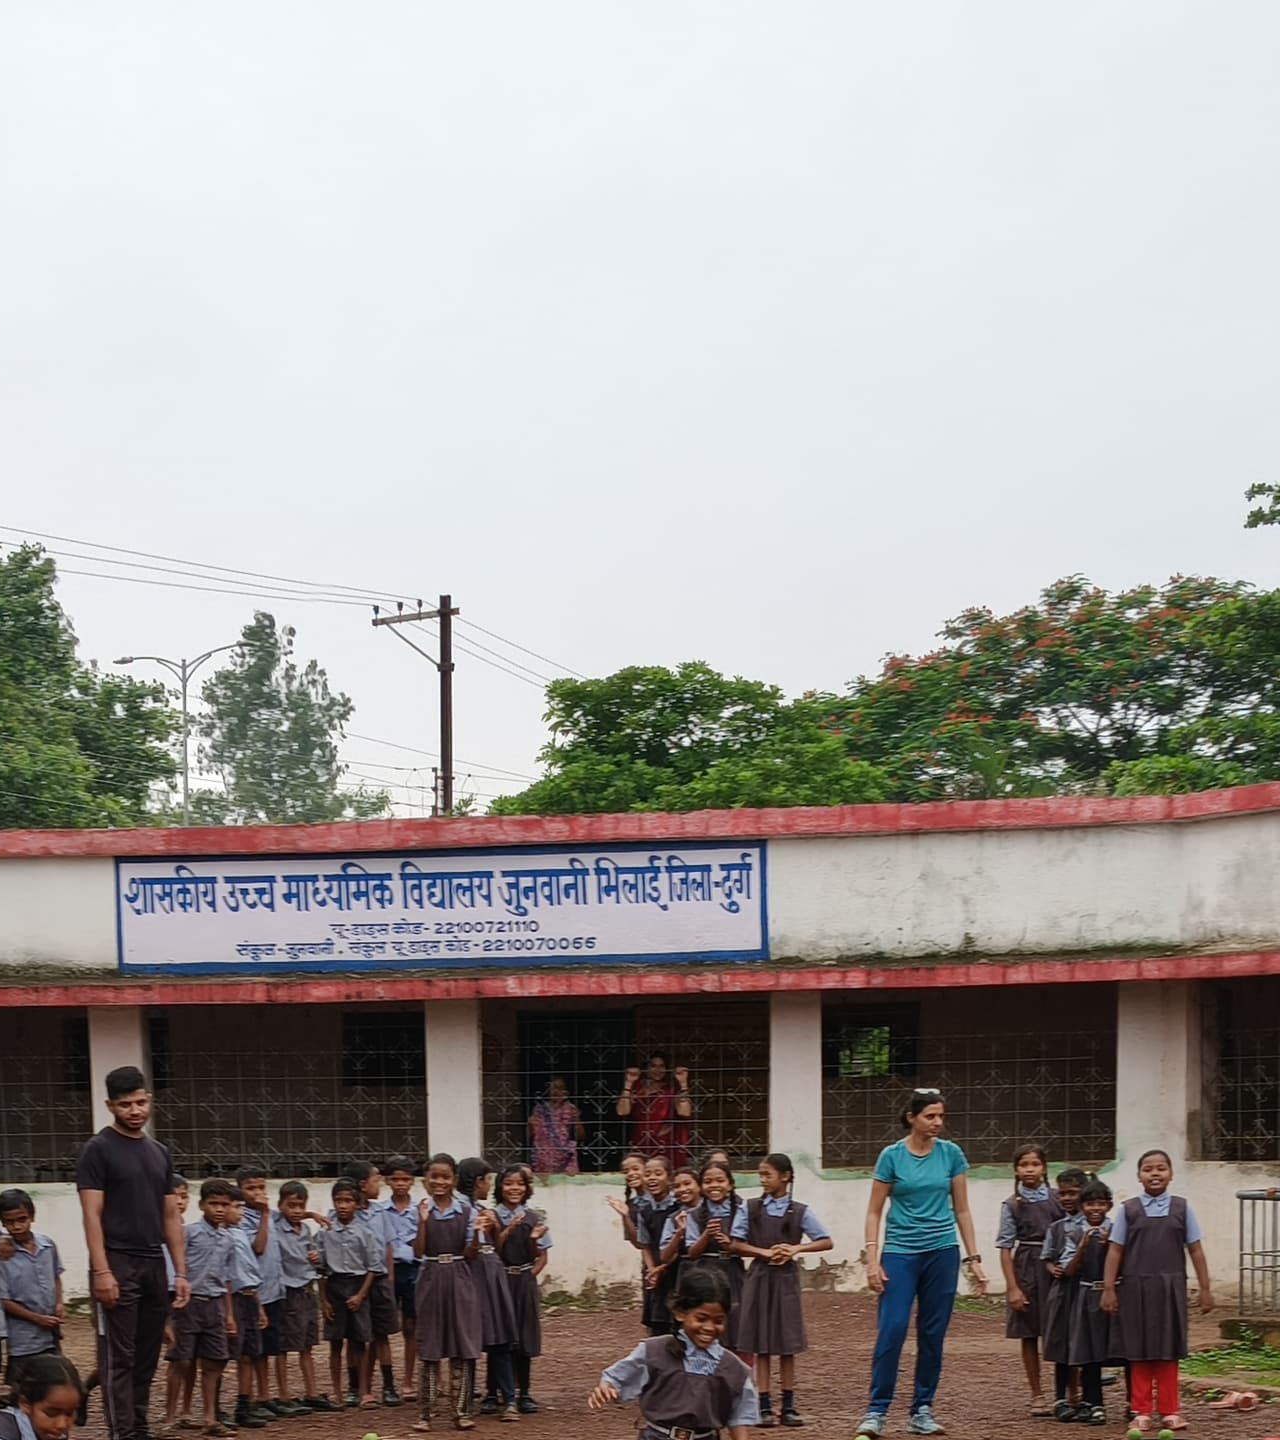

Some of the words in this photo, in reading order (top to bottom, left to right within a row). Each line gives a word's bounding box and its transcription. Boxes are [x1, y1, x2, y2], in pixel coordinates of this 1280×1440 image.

[124, 864, 217, 915] शासकीय
[223, 875, 275, 912] उच्च
[282, 862, 393, 912] माध्यमिक
[399, 861, 494, 910] विद्यालय
[498, 857, 588, 916] जुनवानी
[594, 855, 667, 911] भिलाई
